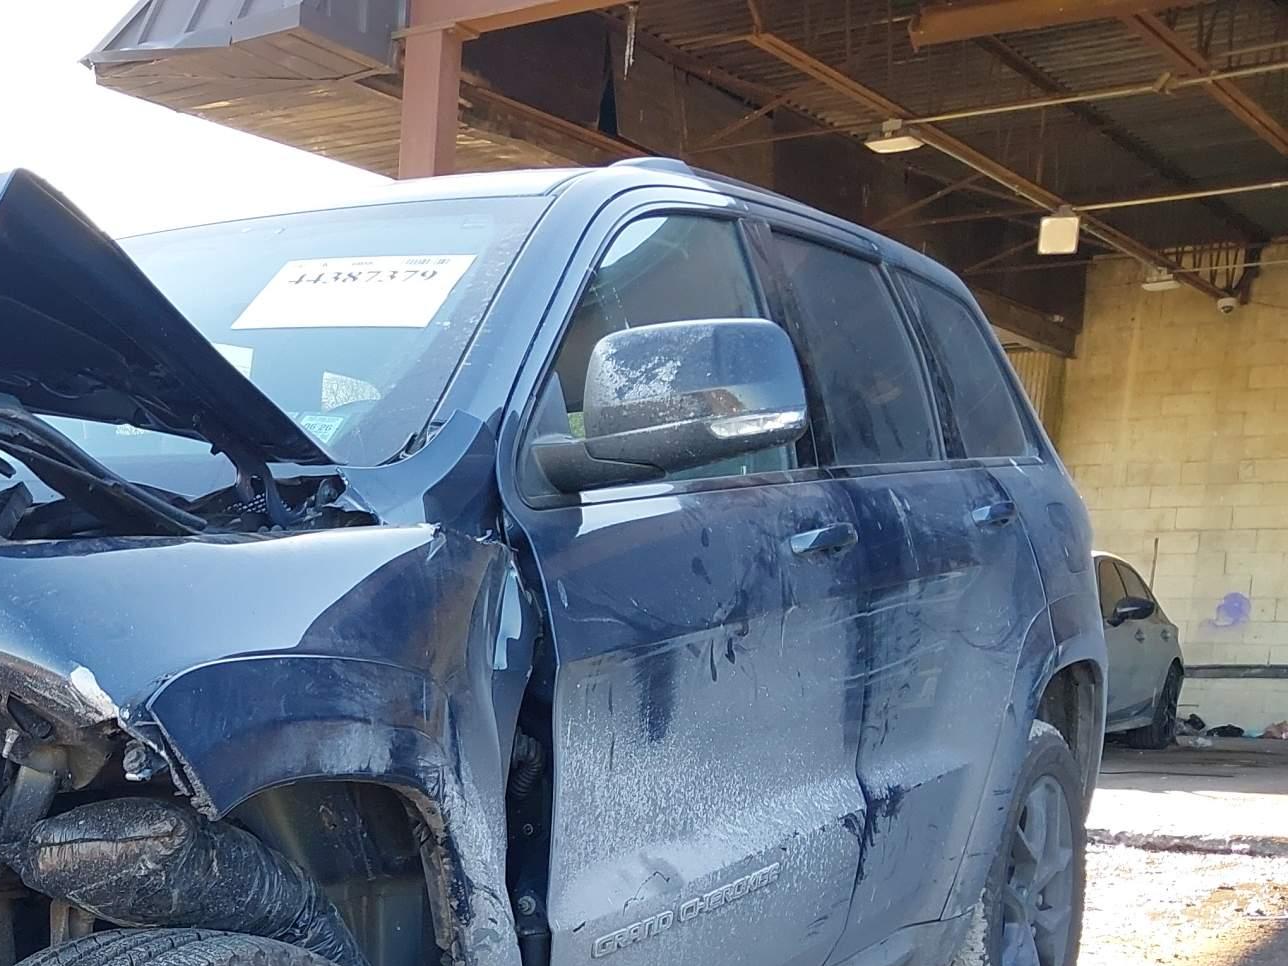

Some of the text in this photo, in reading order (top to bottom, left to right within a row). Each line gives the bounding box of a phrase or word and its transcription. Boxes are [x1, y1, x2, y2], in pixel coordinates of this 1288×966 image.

[288, 268, 439, 285] 44387379
[592, 861, 781, 959] GRAND CHEROKEE
